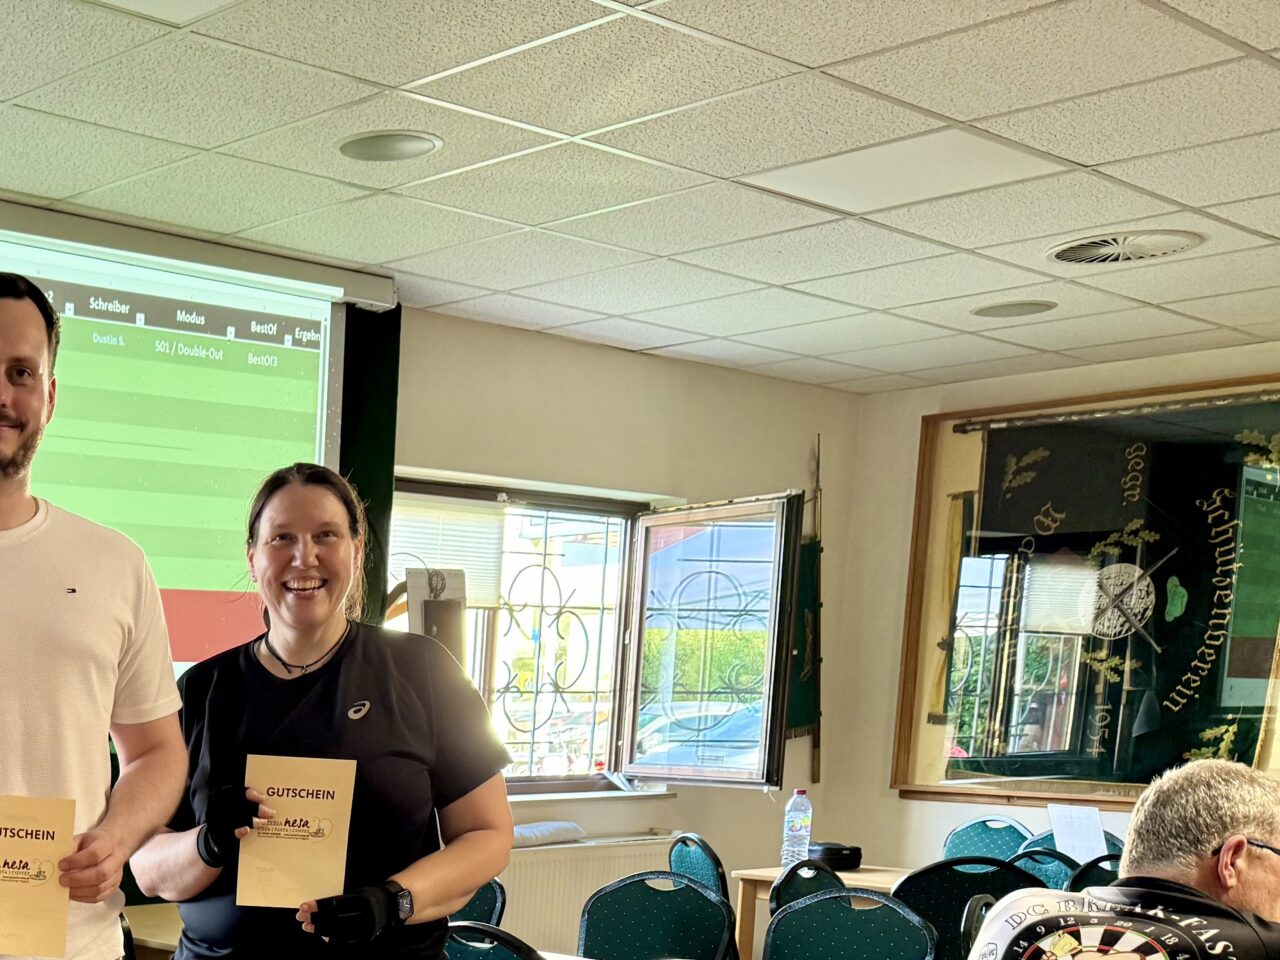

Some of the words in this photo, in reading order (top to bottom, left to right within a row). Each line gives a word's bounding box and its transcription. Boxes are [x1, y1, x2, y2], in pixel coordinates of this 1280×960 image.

[89, 296, 130, 314] Schreiber
[176, 308, 205, 325] Modus
[250, 320, 277, 335] BestOf
[155, 340, 170, 354] 501
[177, 343, 223, 361] Double-Out
[247, 352, 278, 367] BestOf3
[266, 786, 335, 800] GUTSCHEIN
[1004, 904, 1049, 930] DC
[1059, 917, 1075, 926] 12
[1036, 925, 1046, 935] 9
[1161, 932, 1179, 945] 18
[1013, 940, 1029, 952] 14
[1176, 953, 1190, 960] 4
